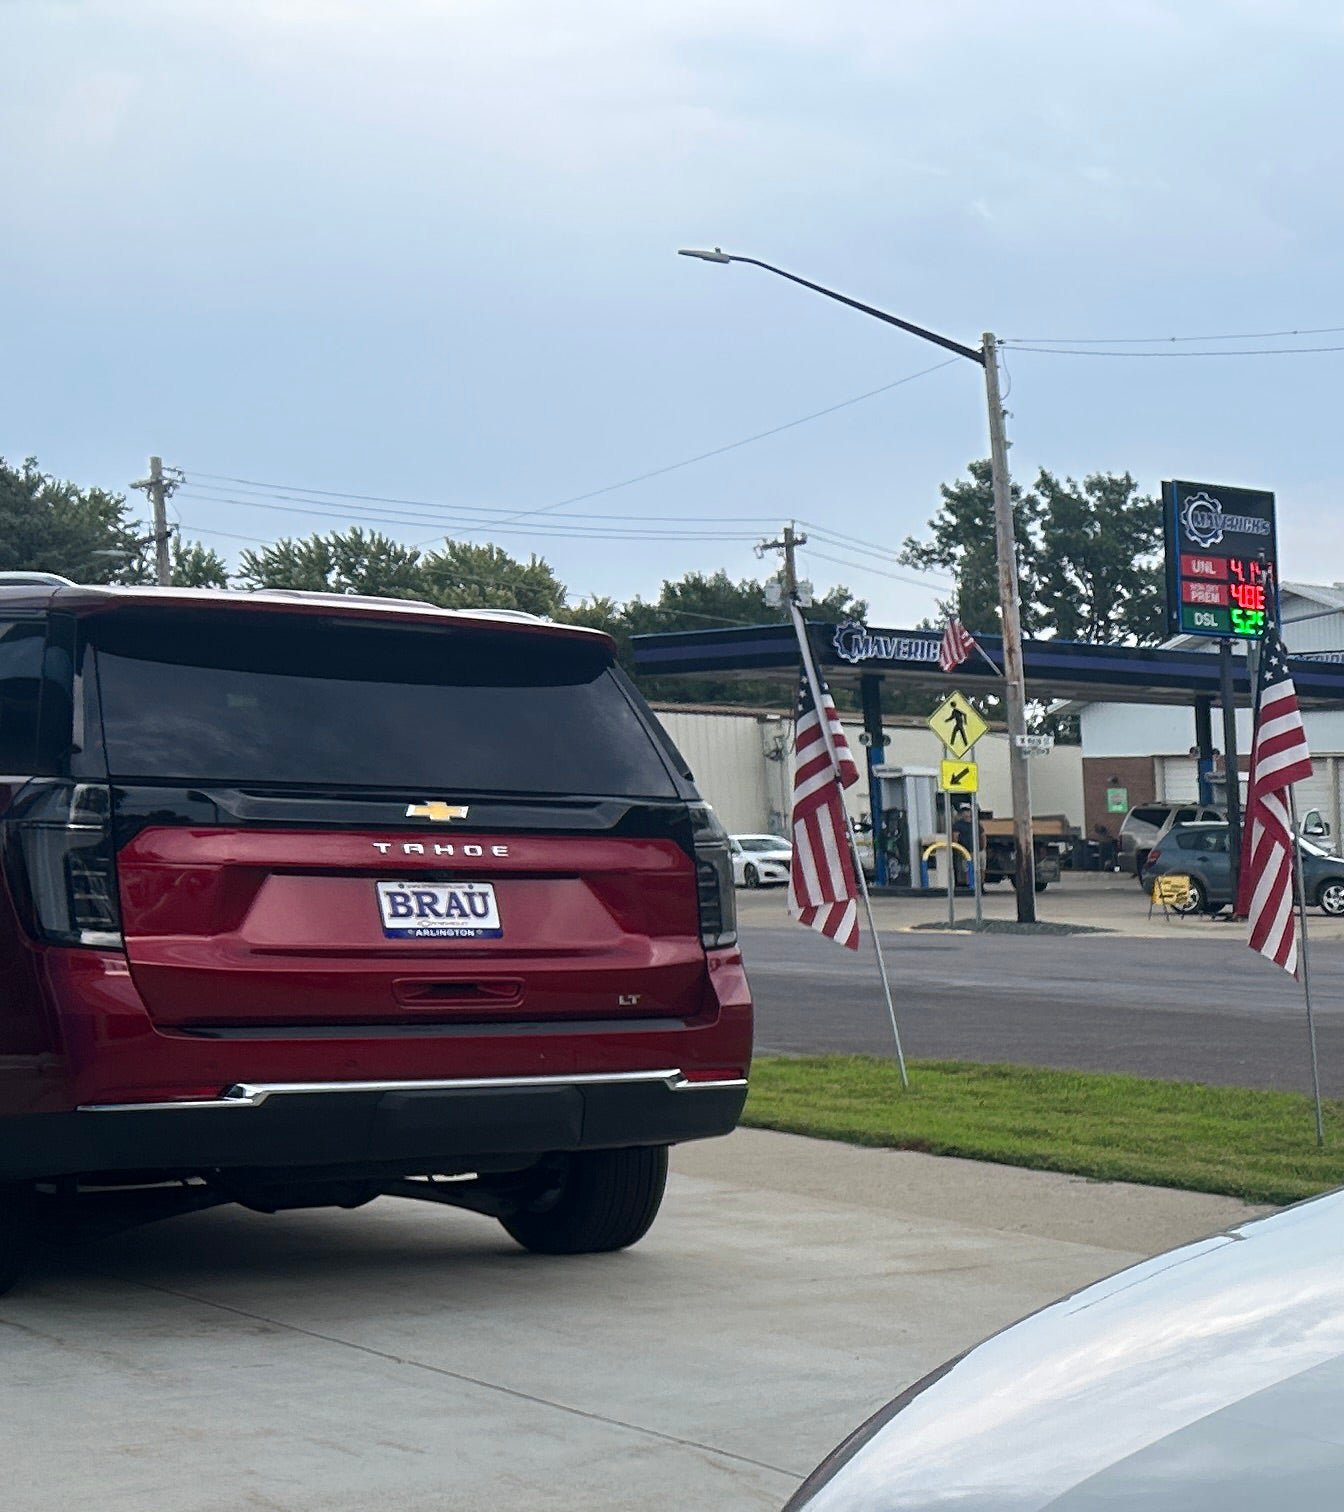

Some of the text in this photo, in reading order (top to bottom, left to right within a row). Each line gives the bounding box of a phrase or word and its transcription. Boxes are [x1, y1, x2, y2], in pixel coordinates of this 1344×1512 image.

[1191, 559, 1217, 575] UNL
[1193, 612, 1219, 627] DSL
[372, 842, 510, 857] TAHOE
[384, 890, 489, 918] BRAU
[415, 928, 475, 937] ARLINGTON
[618, 994, 641, 1006] LT
